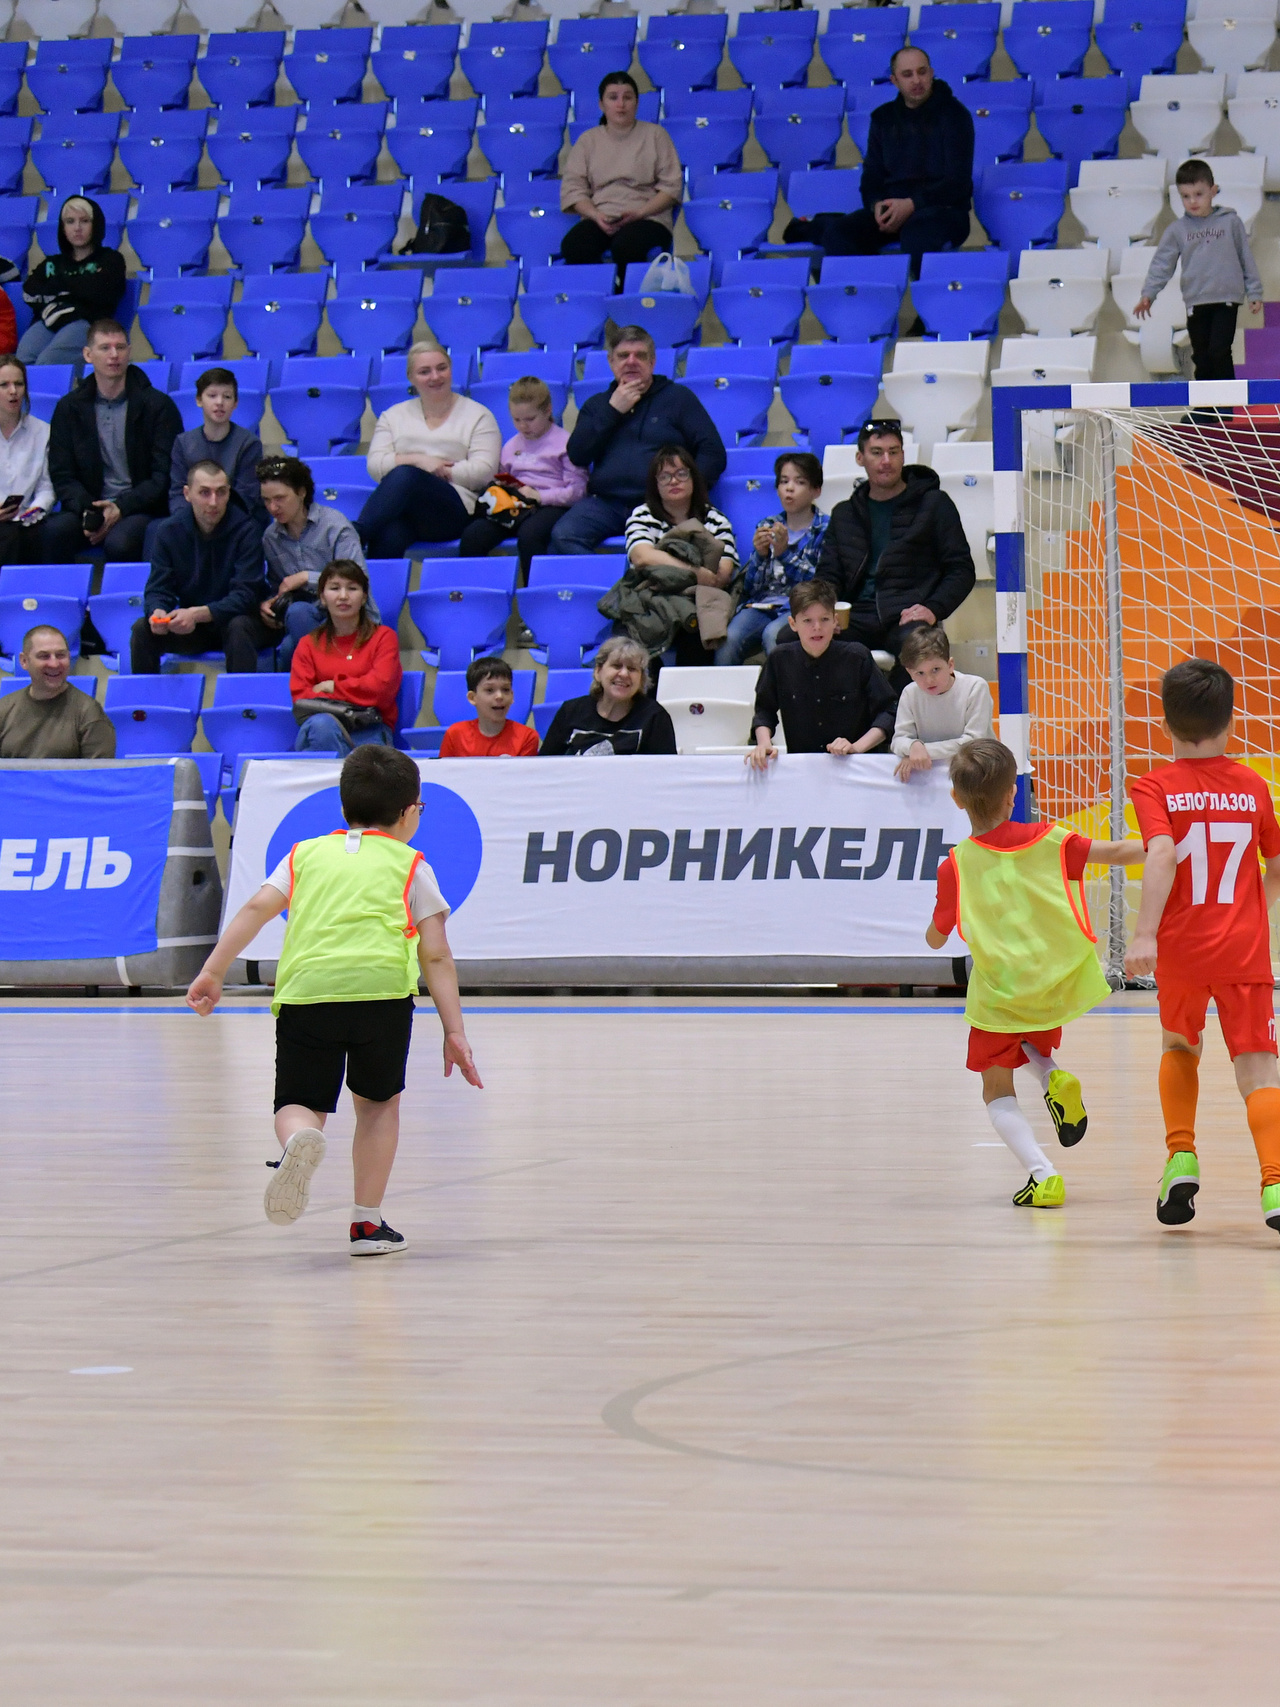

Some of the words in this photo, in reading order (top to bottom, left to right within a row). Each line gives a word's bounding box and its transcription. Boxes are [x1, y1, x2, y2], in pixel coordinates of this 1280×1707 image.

[1166, 791, 1257, 813] БЕЛОГЛАЗОВ
[0, 836, 132, 891] ЕЛЬ
[1175, 821, 1252, 906] 17
